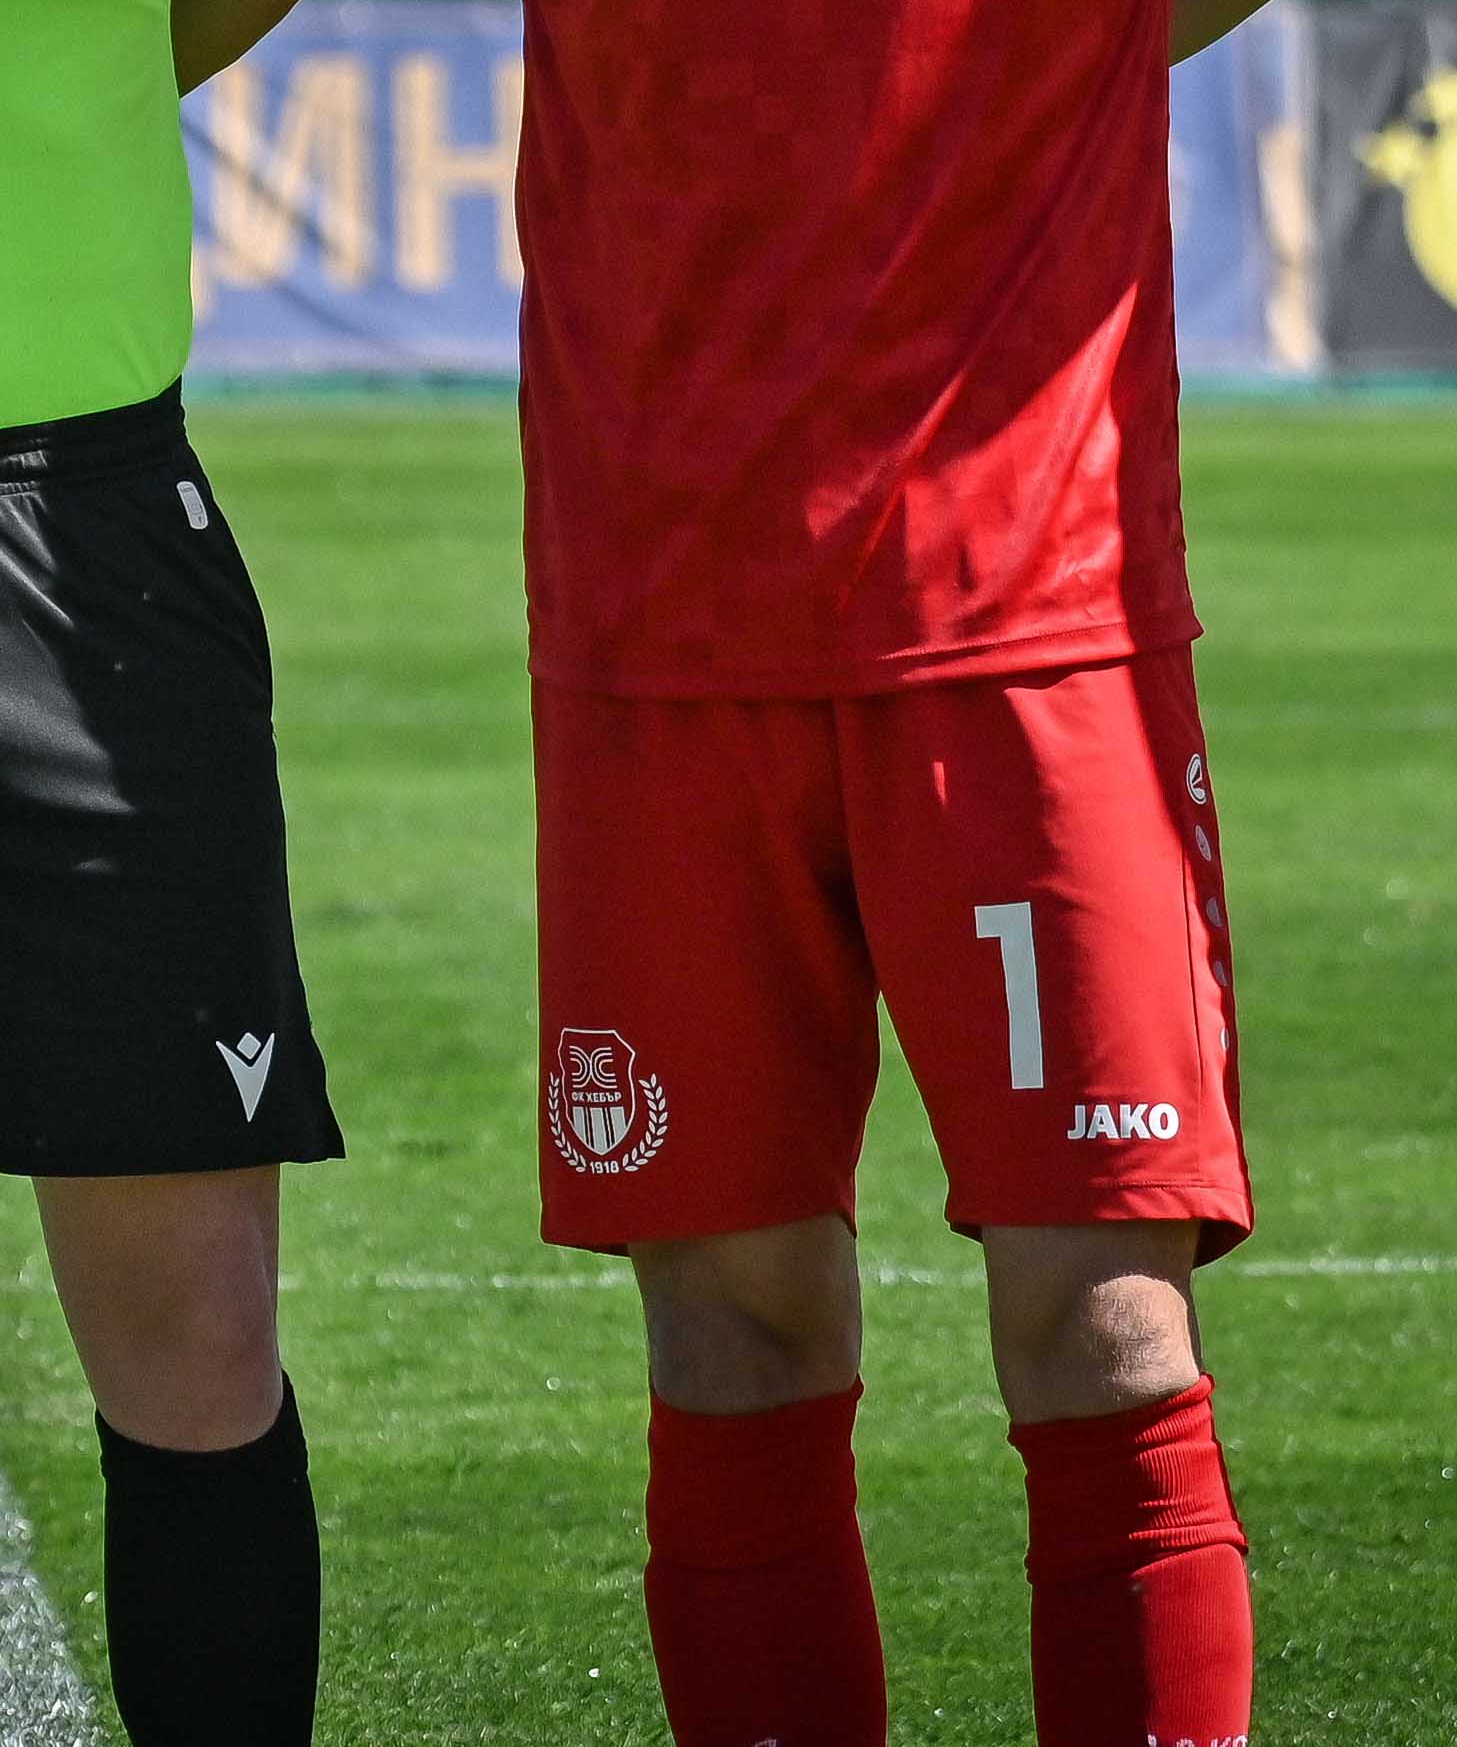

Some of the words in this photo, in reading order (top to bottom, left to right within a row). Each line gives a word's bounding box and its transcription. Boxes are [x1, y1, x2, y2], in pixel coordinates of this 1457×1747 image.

[974, 901, 1044, 1090] 1
[587, 1091, 622, 1103] ХЕБЪР
[1067, 1102, 1181, 1141] JAKO
[590, 1160, 620, 1174] 1918
